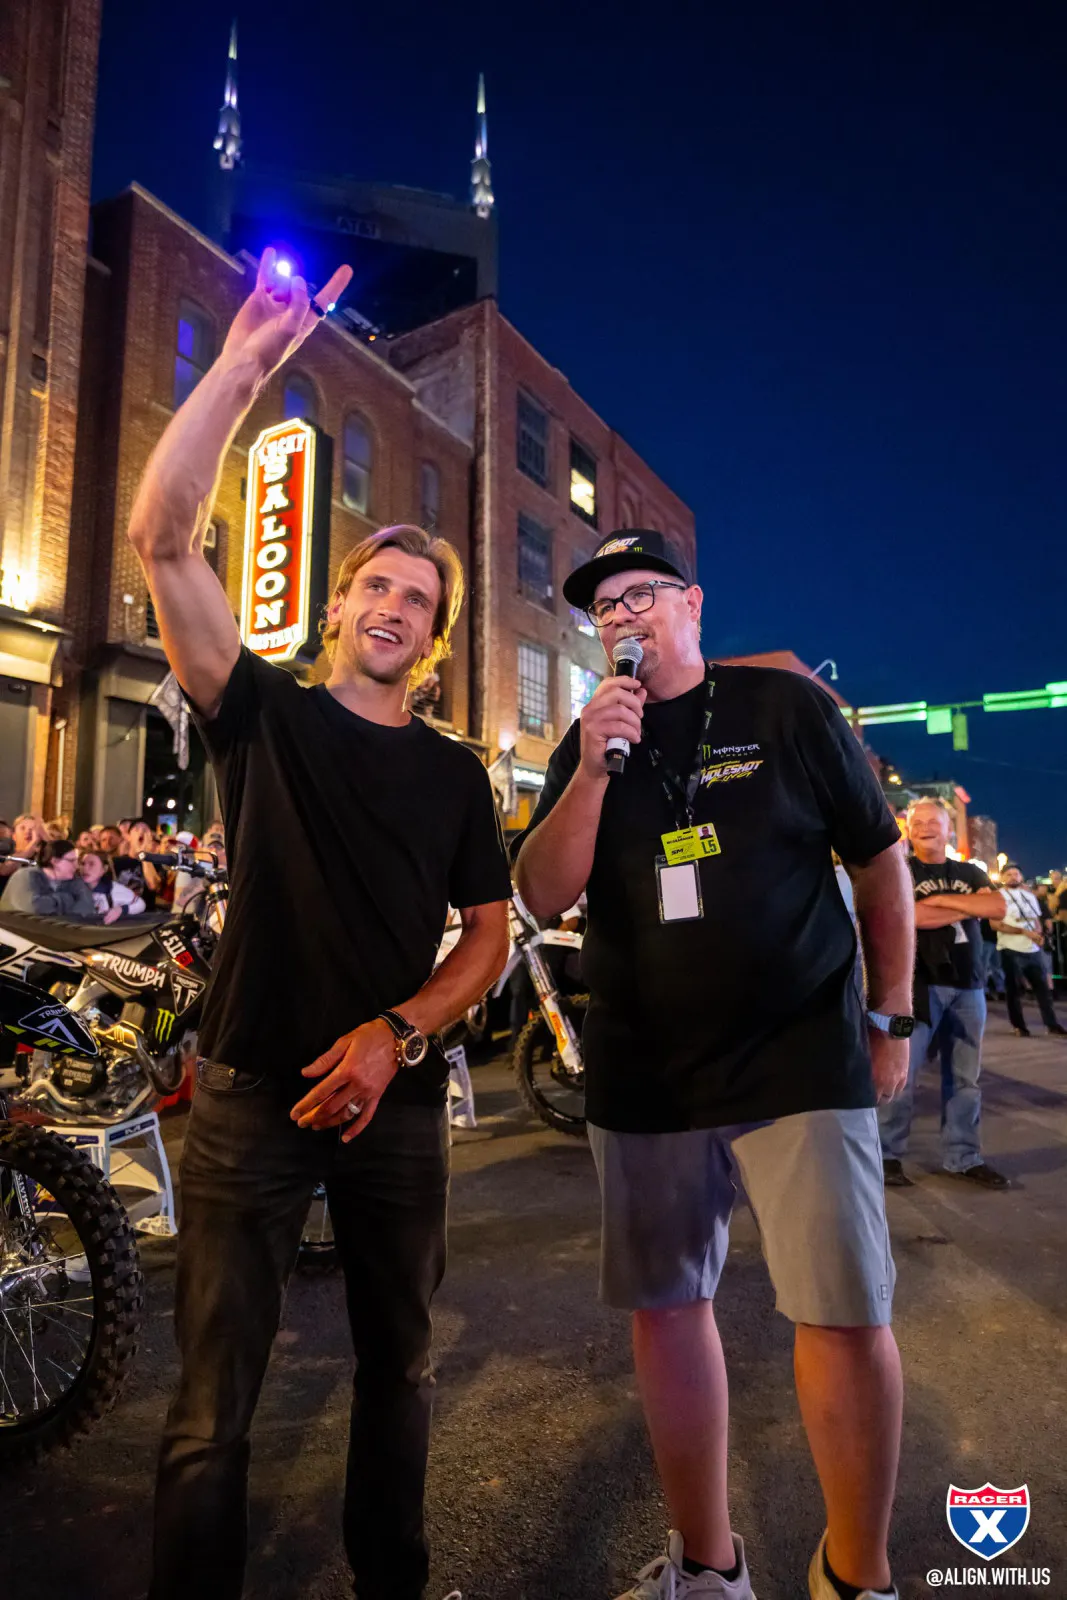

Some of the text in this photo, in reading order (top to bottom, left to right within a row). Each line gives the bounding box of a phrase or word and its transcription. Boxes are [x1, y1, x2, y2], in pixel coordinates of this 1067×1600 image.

[253, 452, 290, 629] SALOON
[713, 743, 760, 755] MONSTER
[700, 760, 764, 785] HOLESHOT
[701, 839, 717, 854] L5
[102, 953, 166, 989] TRIUMPH
